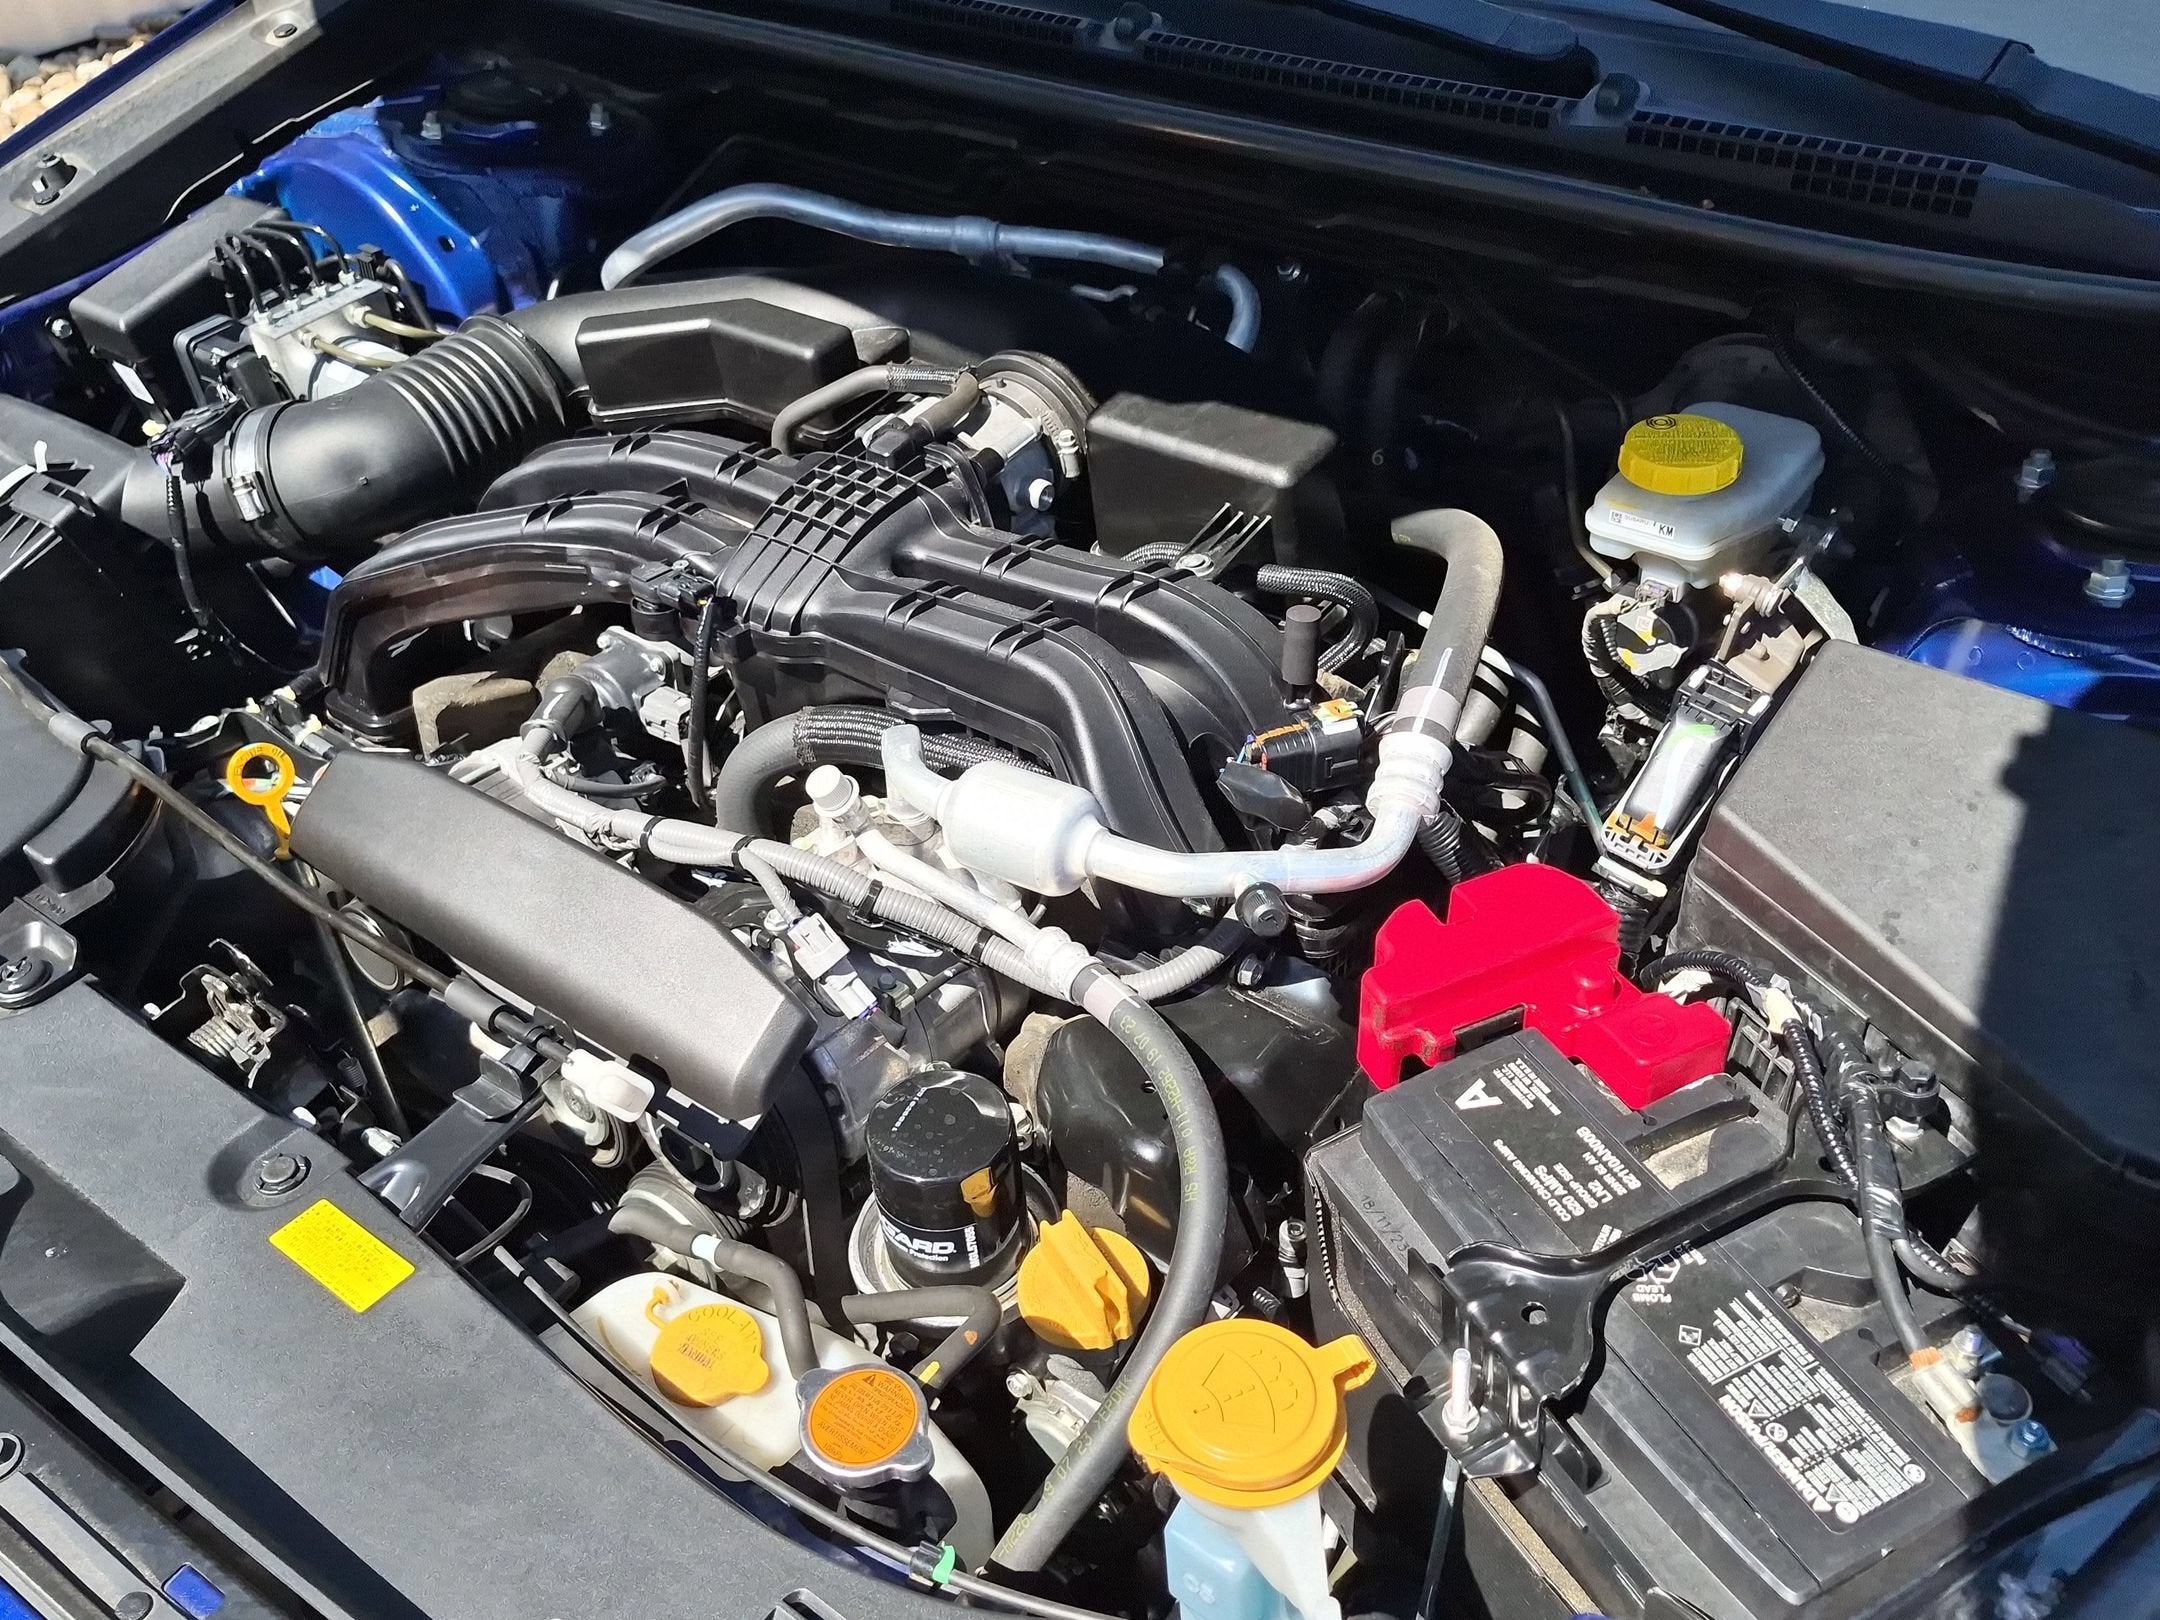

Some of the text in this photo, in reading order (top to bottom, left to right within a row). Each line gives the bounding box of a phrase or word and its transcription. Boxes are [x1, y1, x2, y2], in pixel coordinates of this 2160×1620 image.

[1659, 525, 1674, 537] KM
[1456, 1077, 1503, 1111] A
[1581, 1151, 1598, 1165] AH
[1185, 1182, 1199, 1203] HS
[1492, 1139, 1572, 1221] COLD CRANKING AMPS
[1532, 1165, 1586, 1216] 620 AMPS
[1552, 1162, 1599, 1208] GROUP SIZE
[1586, 1179, 1613, 1202] LN2
[1602, 1173, 1627, 1195] 20HR
[1361, 1195, 1410, 1252] 18/11/23
[908, 1248, 949, 1262] Protection
[964, 1225, 980, 1269] MGL57055
[1632, 1292, 1671, 1302] PLOMB
[1635, 1284, 1664, 1292] LEAD
[877, 1380, 910, 1405] WARNING
[817, 1419, 868, 1457] AVERTISSEMENT
[1717, 1394, 1819, 1499] DANGER/POISON
[1057, 1456, 1072, 1479] 07
[1075, 1435, 1093, 1455] 23
